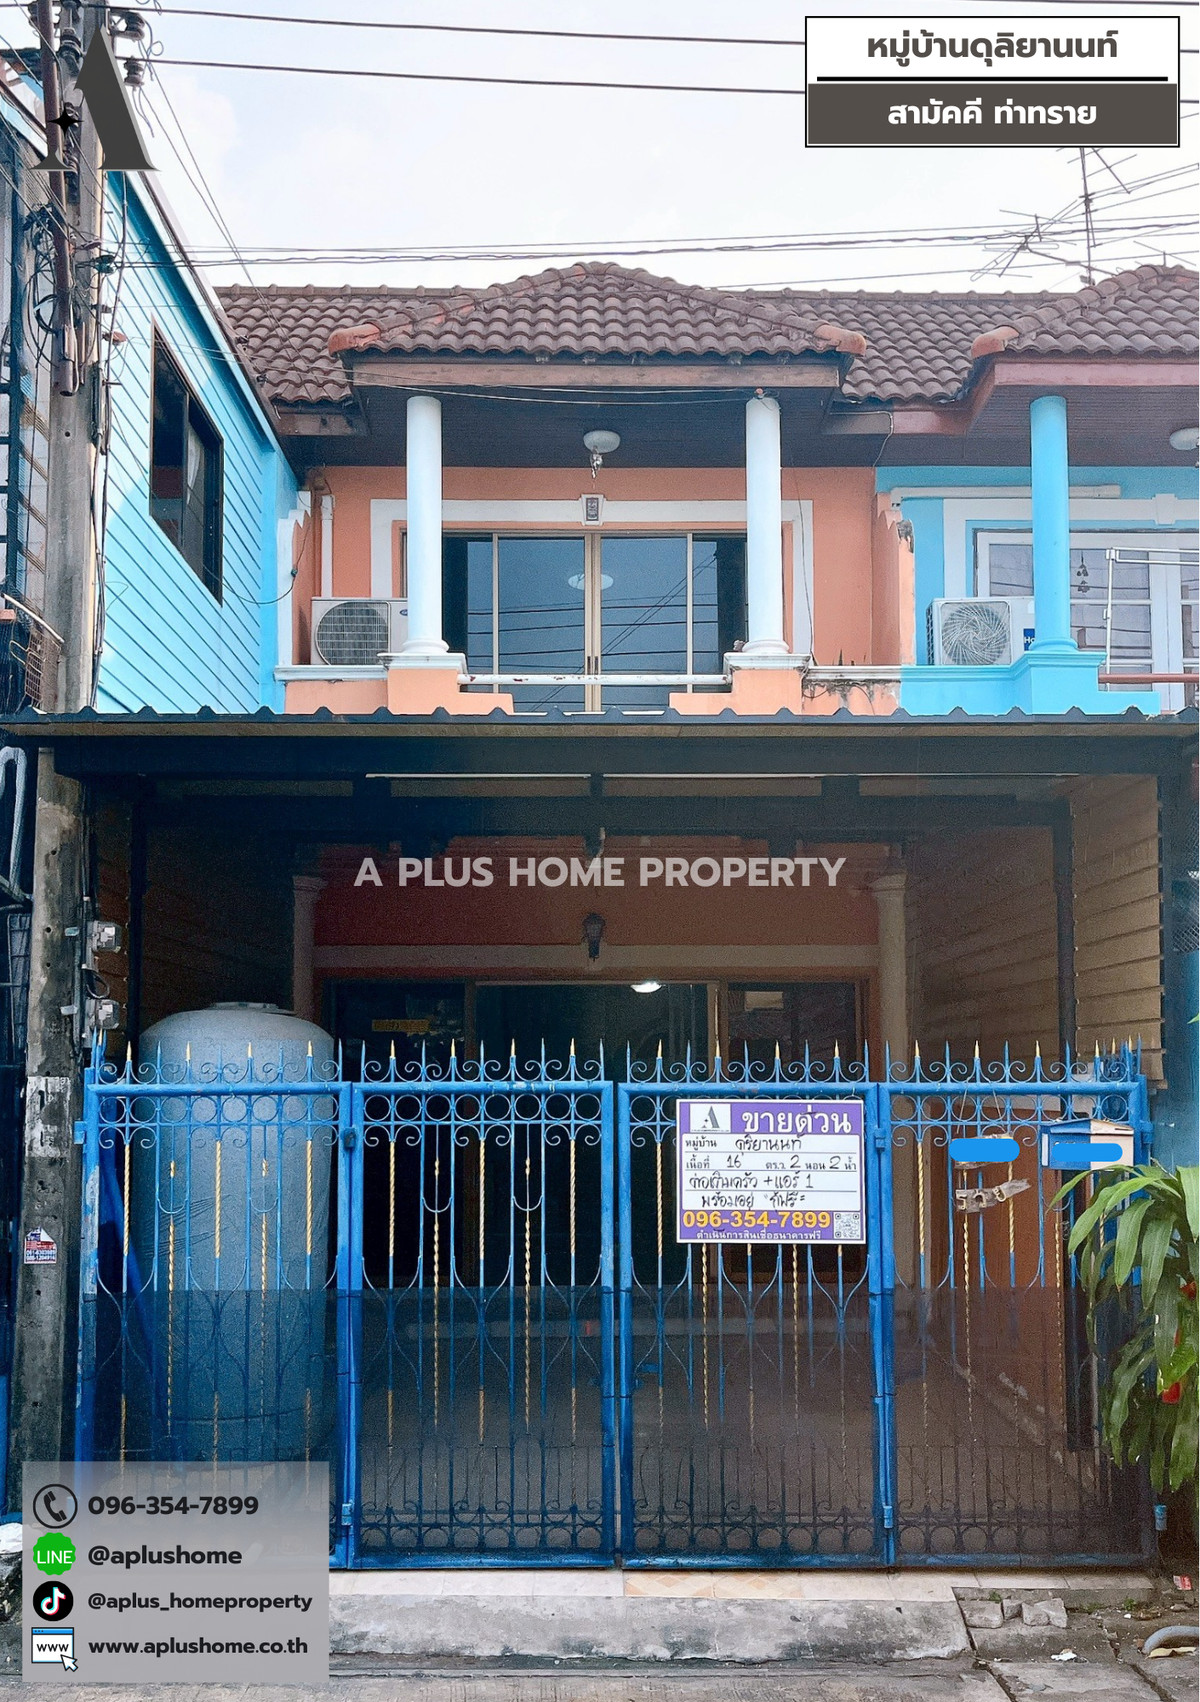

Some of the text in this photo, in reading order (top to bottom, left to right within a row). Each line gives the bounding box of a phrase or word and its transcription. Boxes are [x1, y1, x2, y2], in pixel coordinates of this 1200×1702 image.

[741, 1104, 852, 1133] ขายด่วน
[685, 1135, 717, 1151] หมู่บ้าน
[686, 1154, 710, 1169] เนื้อที่
[726, 1154, 742, 1168] 16
[790, 1155, 801, 1168] 2
[805, 1161, 827, 1170] นอน
[829, 1156, 841, 1169] 2
[844, 1156, 857, 1170] น้ำ
[805, 1173, 814, 1189] 1
[701, 1191, 754, 1210] พร้อมอยู่
[683, 1210, 831, 1228] 096-354-7899
